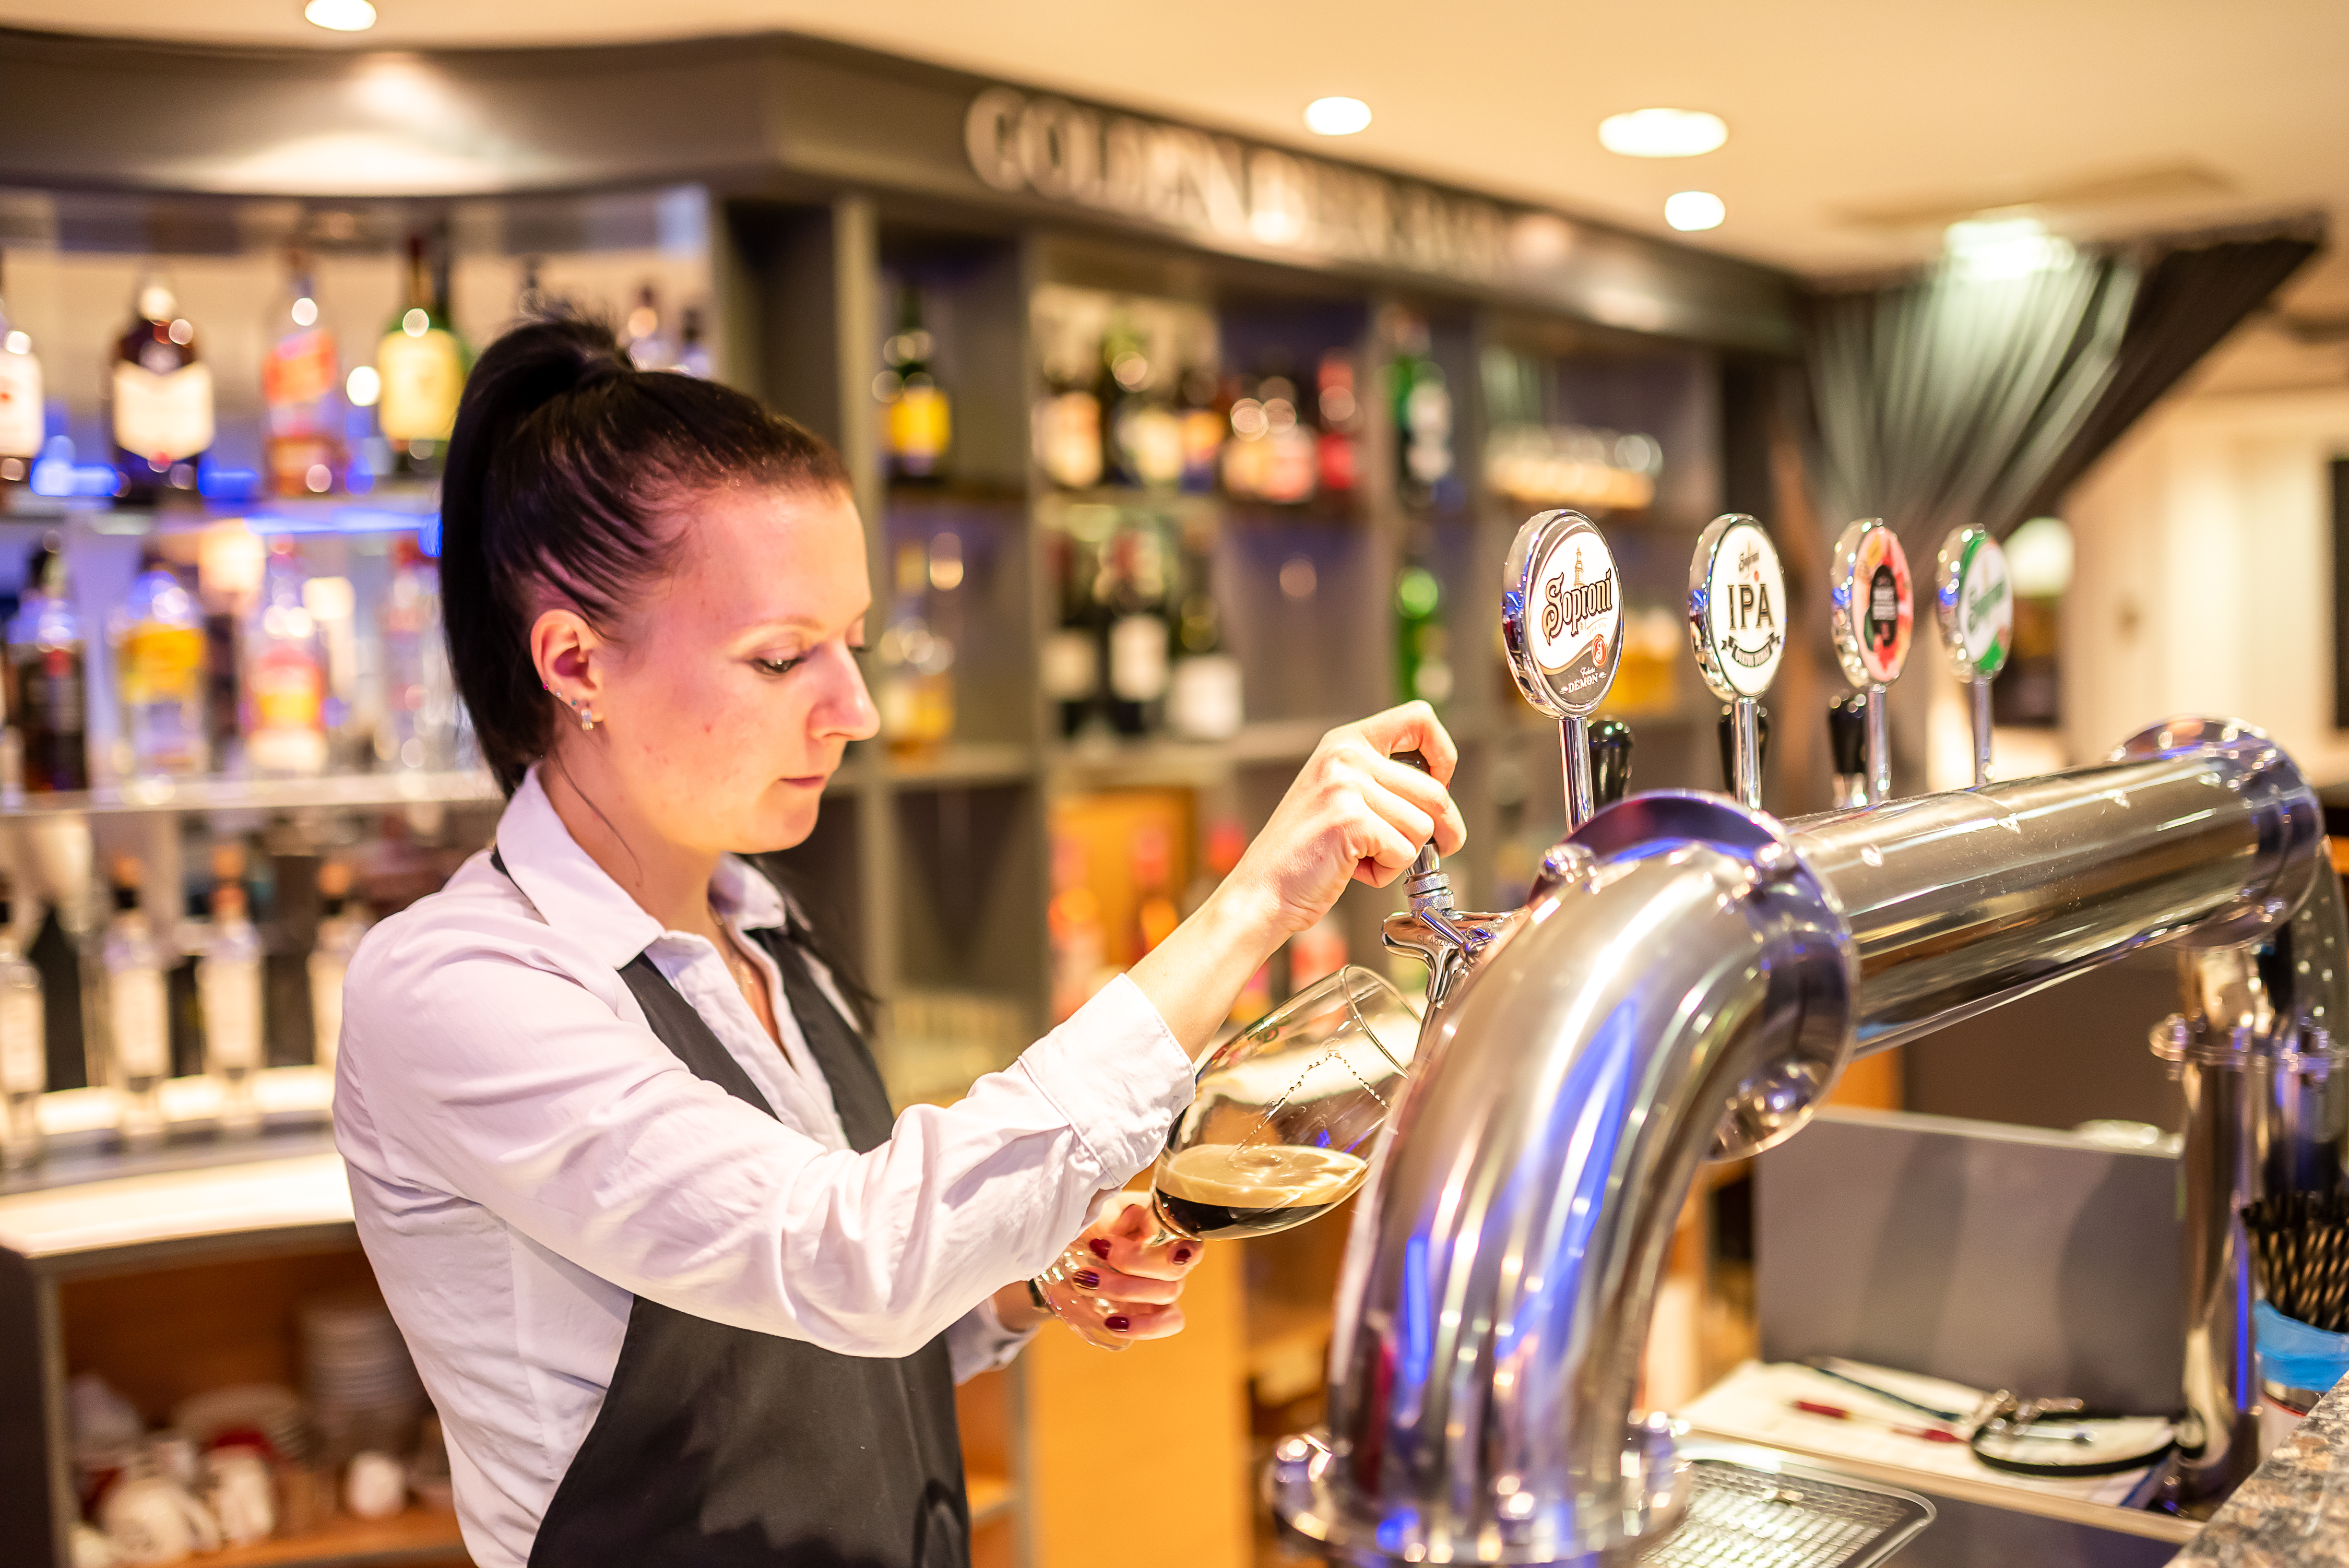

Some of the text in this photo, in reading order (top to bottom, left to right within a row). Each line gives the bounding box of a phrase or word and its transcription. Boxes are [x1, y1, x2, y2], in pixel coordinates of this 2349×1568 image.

[1542, 567, 1612, 646] Soproni
[1727, 584, 1775, 630] IPA
[1417, 935, 1427, 945] SL
